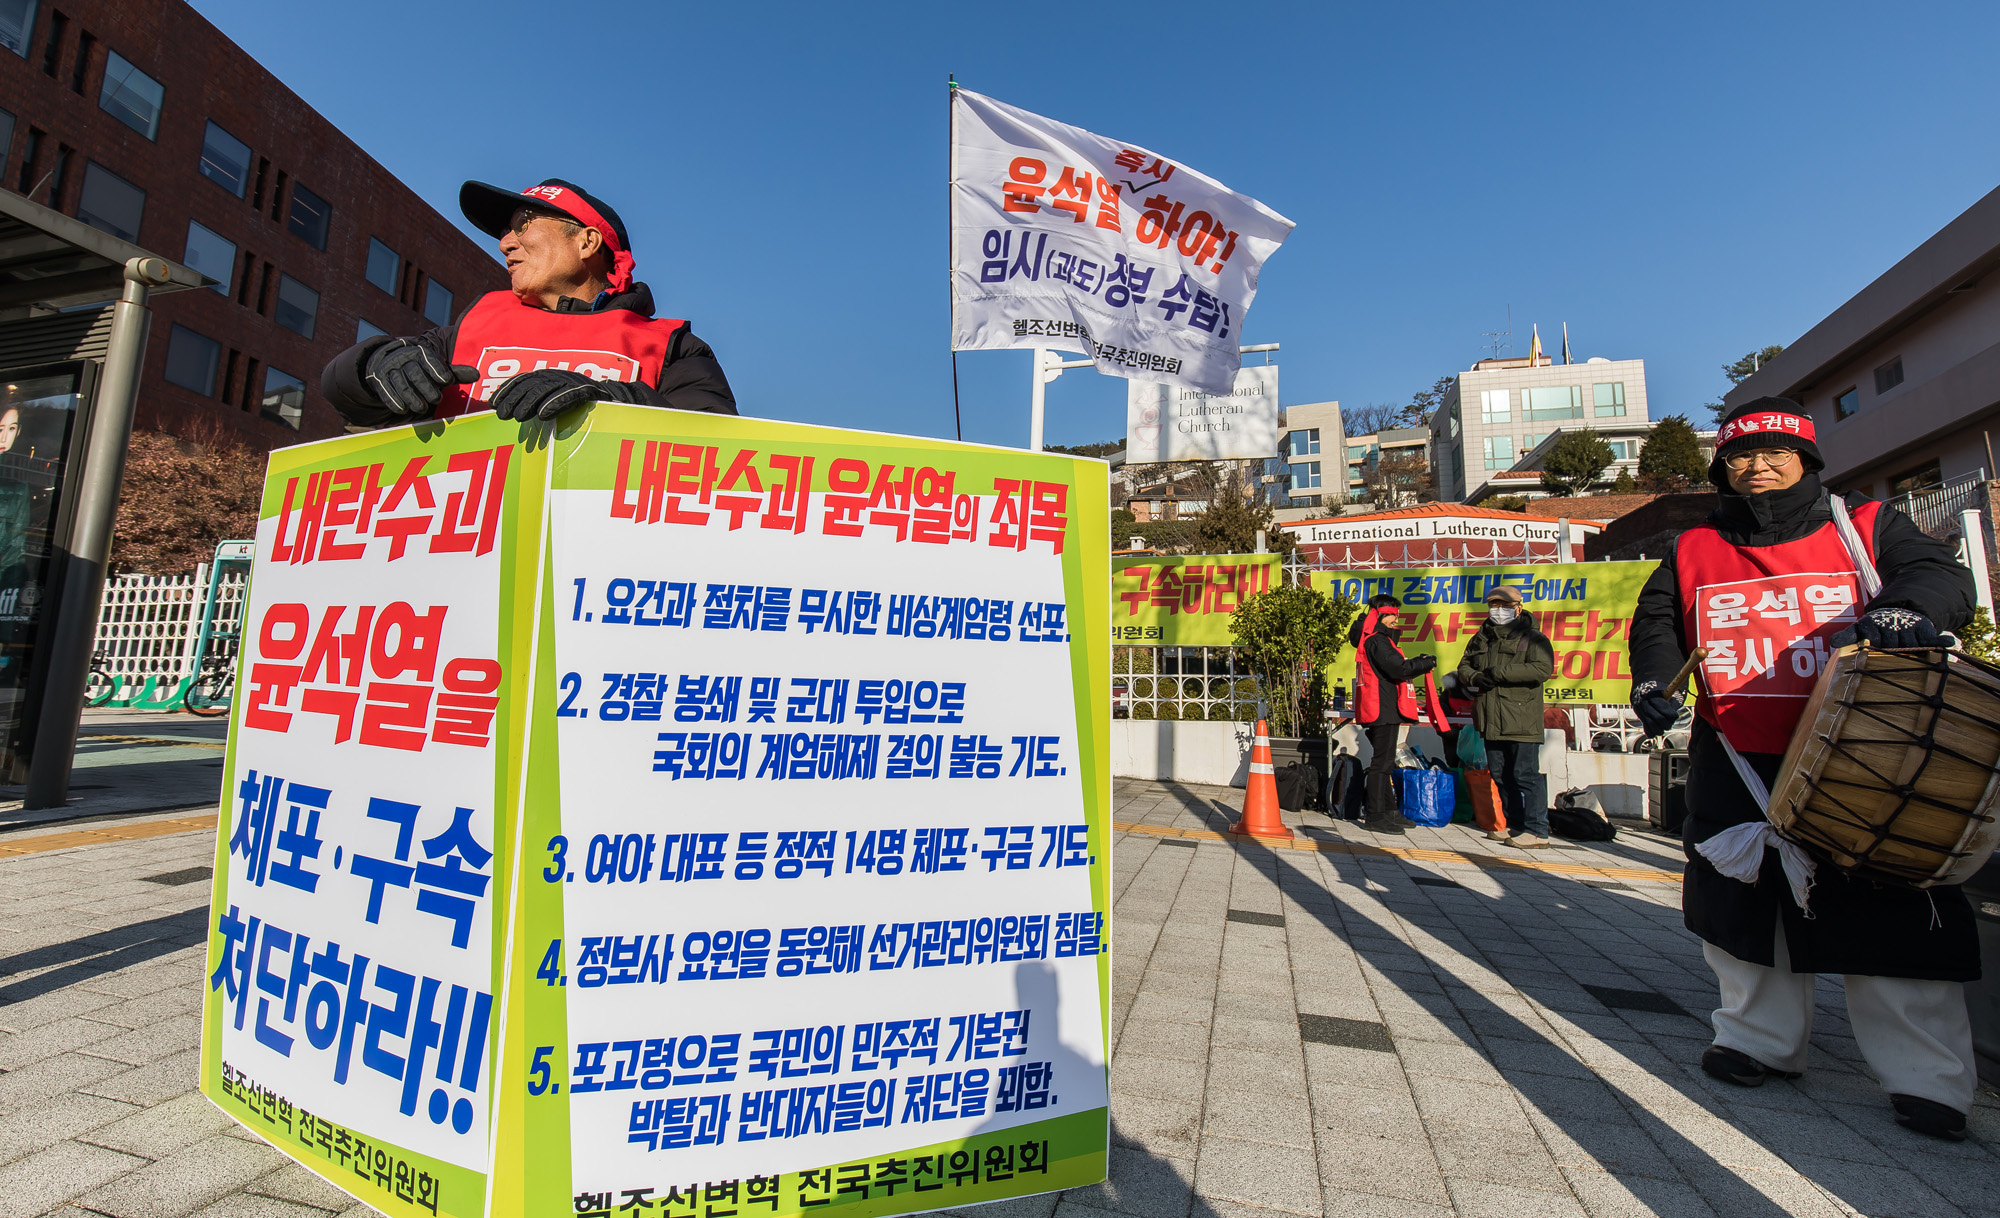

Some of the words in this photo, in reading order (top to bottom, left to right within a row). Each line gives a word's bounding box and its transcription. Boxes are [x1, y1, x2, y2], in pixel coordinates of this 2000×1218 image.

[1115, 150, 1176, 181] 즉시
[1002, 157, 1122, 234] 윤석열
[1136, 195, 1238, 274] 하야!
[1091, 340, 1183, 375] 전국추진위원회
[1178, 417, 1230, 433] Church
[1179, 402, 1243, 417] Lutheran
[1762, 415, 1799, 433] 권력
[271, 445, 514, 565] 내란수괴
[610, 440, 815, 534] 내란수괴
[823, 458, 980, 544] 윤석열의
[989, 478, 1068, 555] 죄목
[239, 545, 248, 553] kt
[1311, 521, 1420, 541] International
[1433, 520, 1507, 537] Lutheran
[1513, 524, 1560, 540] Churc
[573, 578, 592, 621] 1.
[602, 579, 696, 628] 요건과
[704, 584, 792, 631] 절차를
[798, 589, 881, 635] 무시한
[887, 595, 1013, 641] 비상계엄령
[1018, 602, 1070, 642] 선포.
[1402, 573, 1588, 605] 경제대국에서
[1707, 584, 1857, 629] 윤석열
[245, 602, 502, 752] 윤석열을
[1705, 637, 1775, 680] 즉시
[1788, 635, 1832, 680] 하
[557, 672, 587, 718] 2.
[600, 673, 668, 721] 경찰
[674, 675, 742, 722] 봉쇄
[747, 677, 781, 723] 및
[787, 678, 849, 724] 군대
[855, 680, 966, 725] 투입으로
[653, 733, 752, 780] 국회의
[756, 733, 880, 780] 계엄해제
[886, 734, 943, 779] 결의
[949, 735, 1002, 778] 불능
[1009, 736, 1066, 778] 기도.
[229, 770, 494, 949] 체포·구속
[544, 836, 574, 882] 3.
[586, 834, 656, 884] 여야
[660, 834, 729, 882] 대표
[735, 832, 768, 880] 등
[774, 831, 837, 879] 정적
[846, 829, 907, 875] 14명
[910, 826, 1034, 874] 체포·구금
[1039, 825, 1094, 868] 기도.
[537, 940, 567, 985] 4.
[577, 934, 674, 988] 정보사
[678, 929, 771, 981] 요원을
[777, 925, 865, 977] 동원해
[868, 915, 1050, 970] 선거관리위원회
[1055, 912, 1107, 957] 침탈.
[210, 904, 494, 1135] 처단하라!!
[528, 1046, 559, 1095] 5.
[570, 1034, 741, 1093] 포고령으로
[749, 1025, 845, 1080] 국민의
[852, 1018, 941, 1071] 민주적
[946, 1009, 1031, 1062] 기본권
[628, 1094, 731, 1151] 박탈과
[738, 1079, 897, 1141] 반대자들의
[901, 1066, 989, 1124] 처단을
[995, 1062, 1058, 1112] 꾀함.
[221, 1060, 293, 1134] 헬조선변혁
[299, 1107, 439, 1217] 전국추진위원회
[574, 1174, 780, 1218] 헬조선변혁
[796, 1141, 1049, 1206] 전국추진위원회
